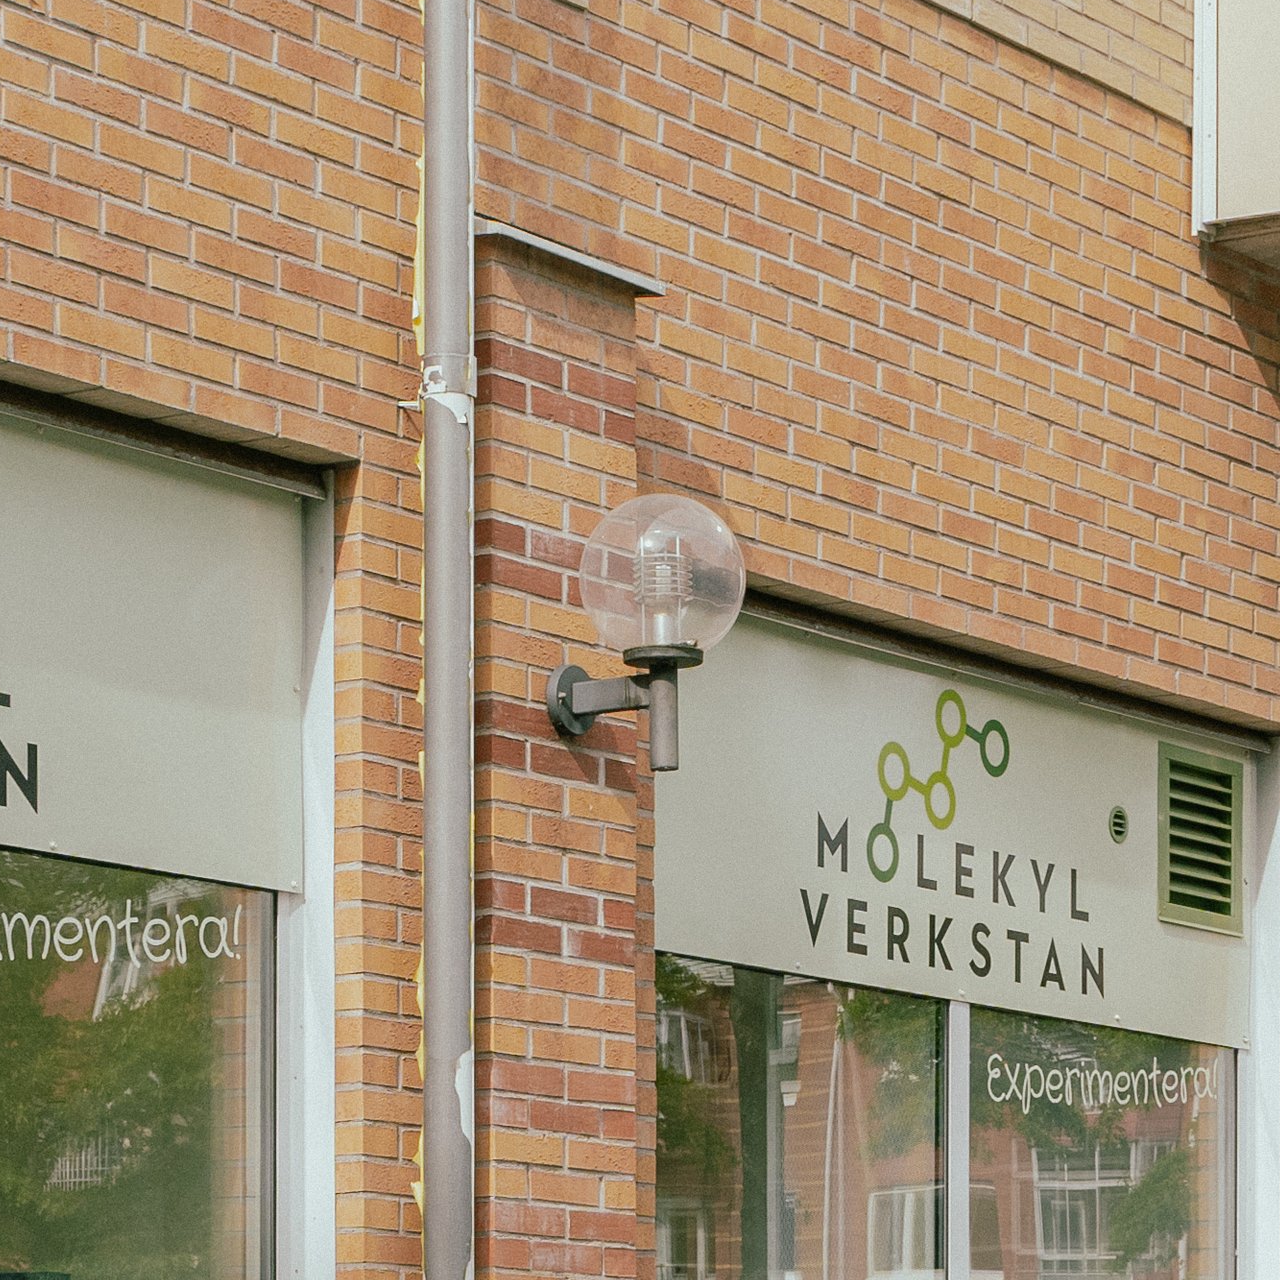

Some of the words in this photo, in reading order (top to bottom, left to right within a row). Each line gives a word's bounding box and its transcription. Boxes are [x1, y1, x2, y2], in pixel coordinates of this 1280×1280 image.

[817, 811, 1089, 921] MOLEKYL
[800, 888, 1105, 999] VERKSTAN
[987, 1053, 1219, 1115] Experimentera!
